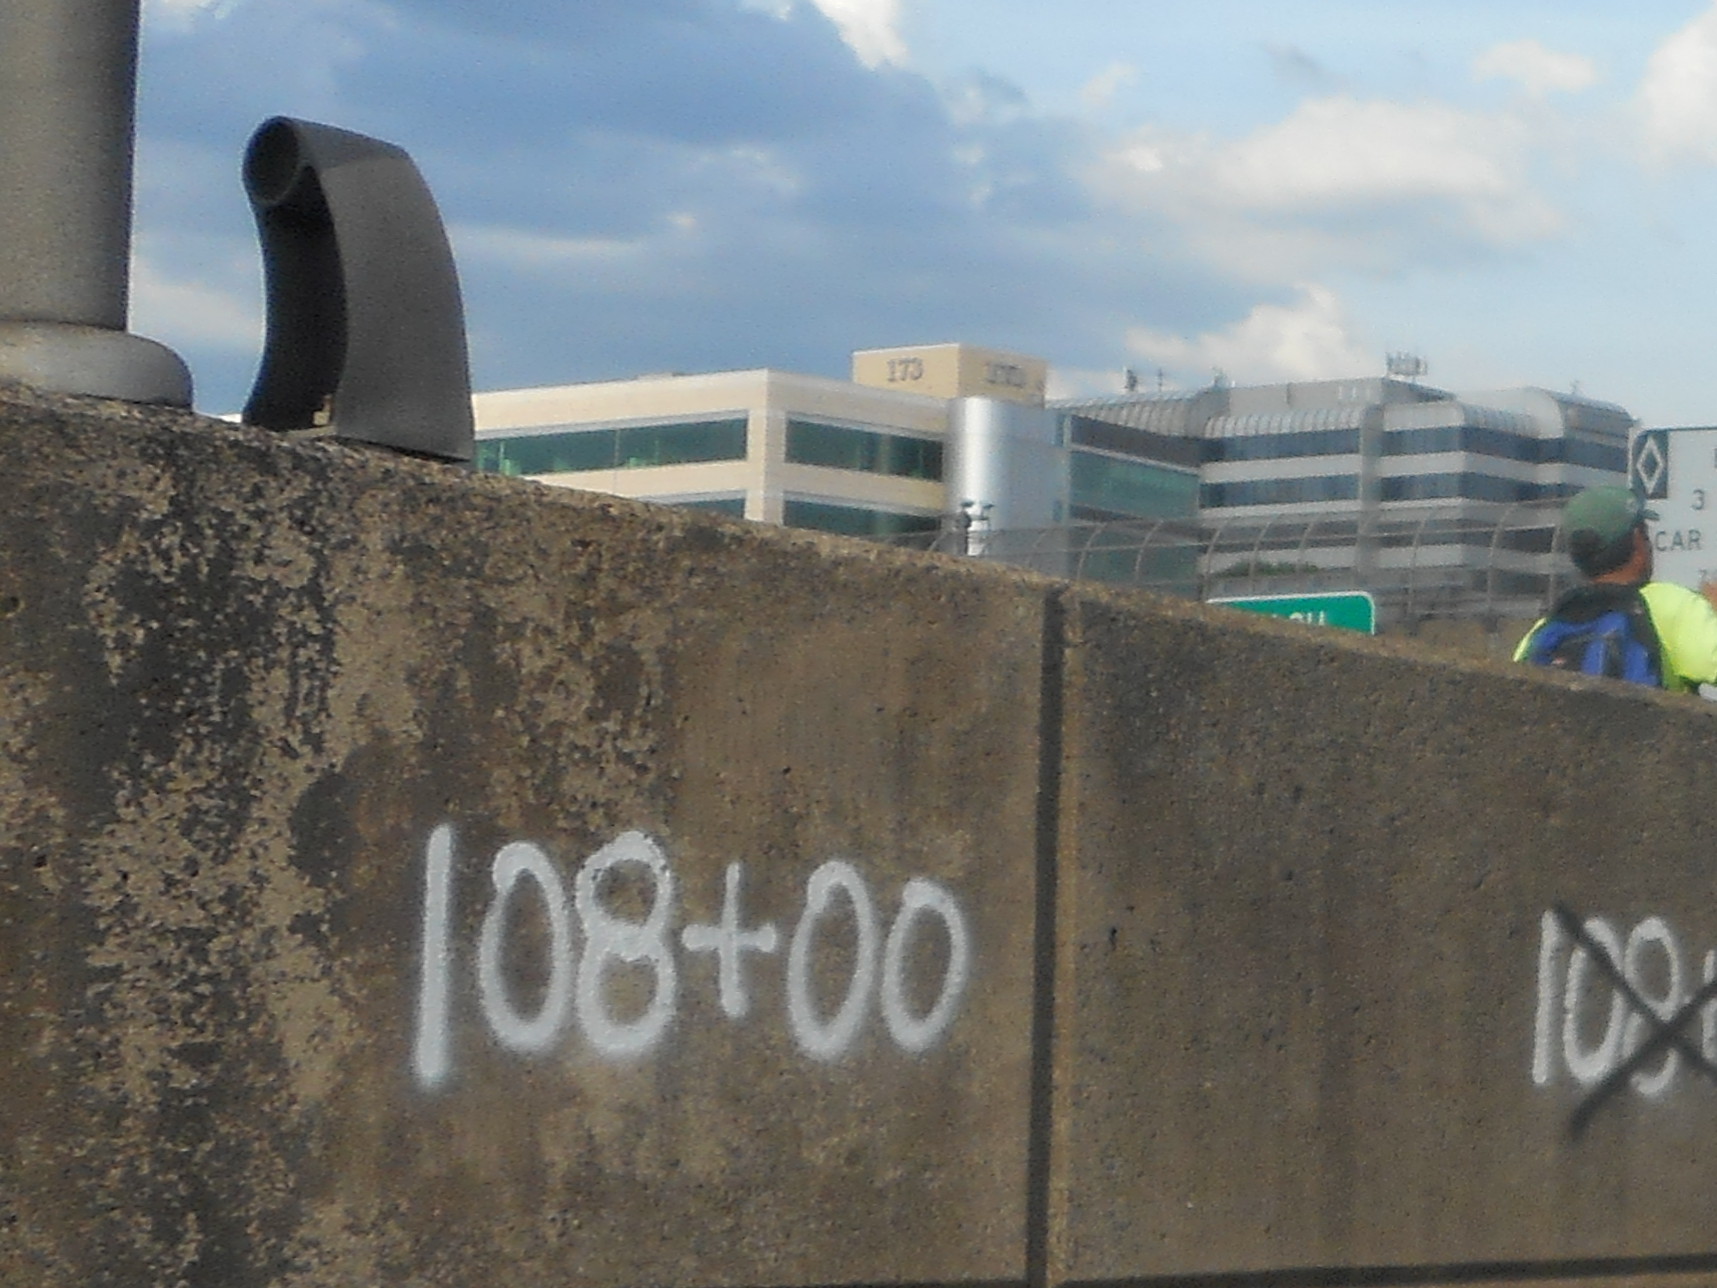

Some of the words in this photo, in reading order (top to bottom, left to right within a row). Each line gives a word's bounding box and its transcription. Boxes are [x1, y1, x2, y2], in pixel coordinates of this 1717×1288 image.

[1690, 488, 1706, 511] 3
[1654, 528, 1703, 552] CAR
[410, 818, 974, 1094] 108+00
